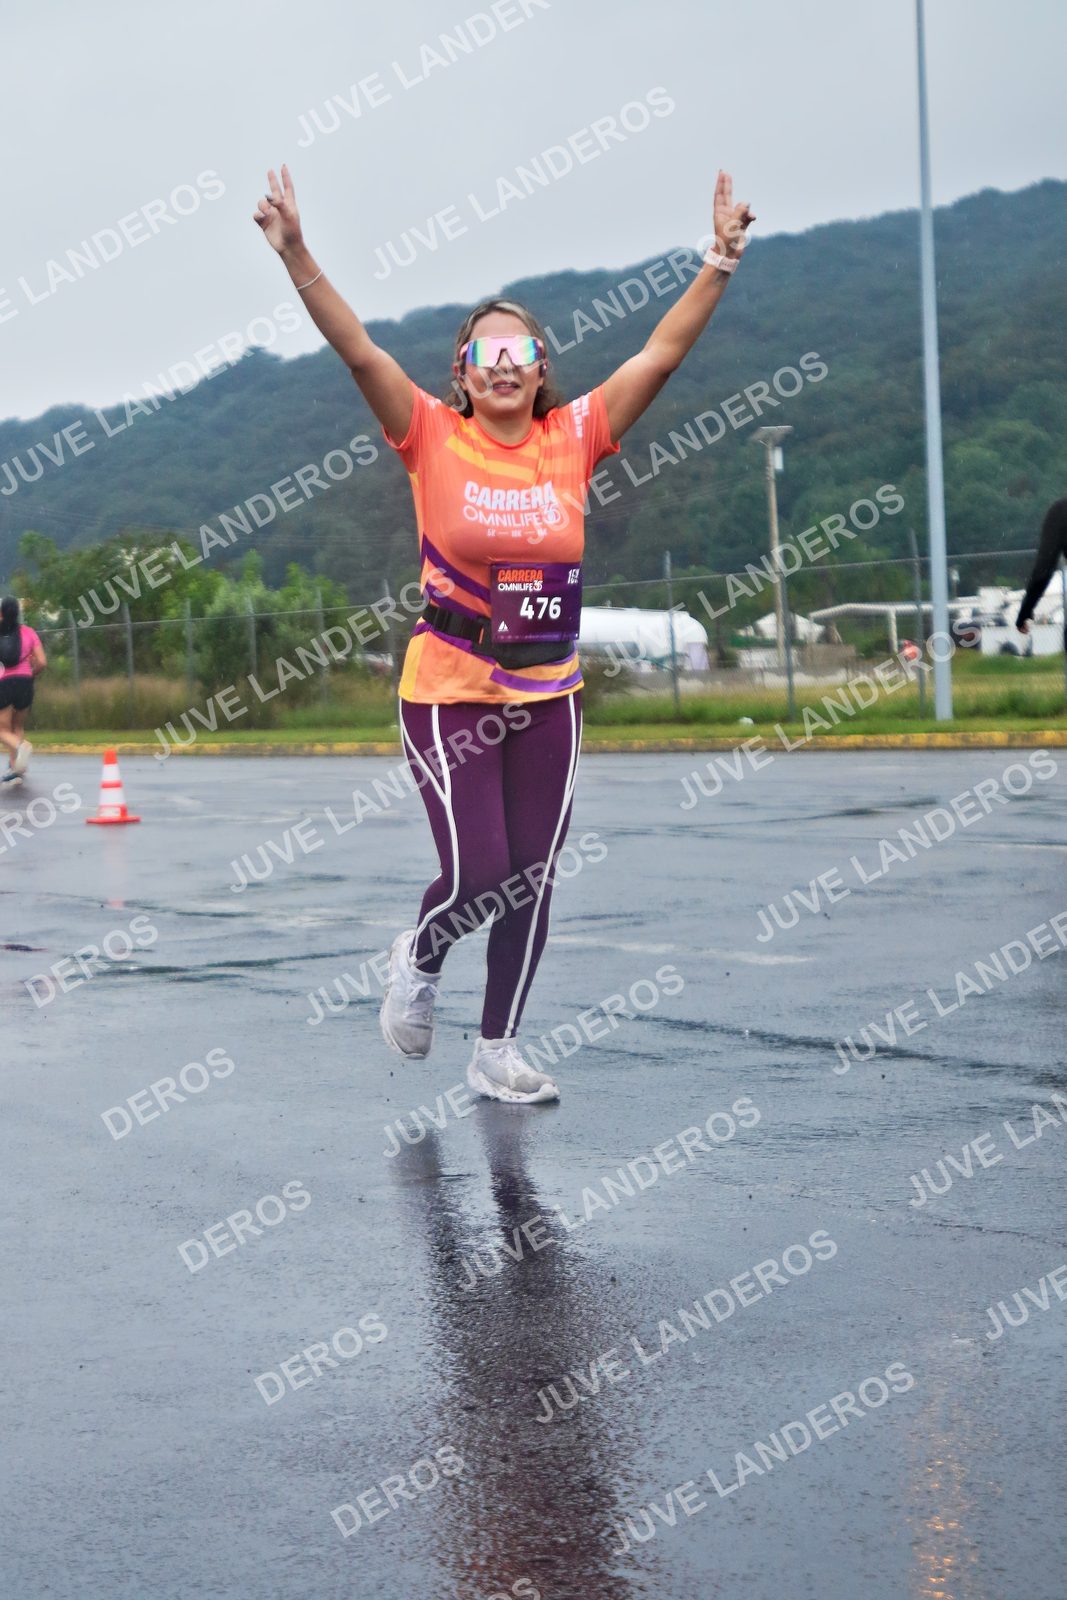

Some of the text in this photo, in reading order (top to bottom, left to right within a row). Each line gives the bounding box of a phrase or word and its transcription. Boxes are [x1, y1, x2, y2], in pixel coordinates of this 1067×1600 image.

[464, 480, 558, 512] CARRERA
[463, 504, 543, 527] OMNILIFE
[498, 569, 544, 583] CARRERA
[498, 582, 533, 592] OMNILIFE
[520, 596, 562, 620] 476
